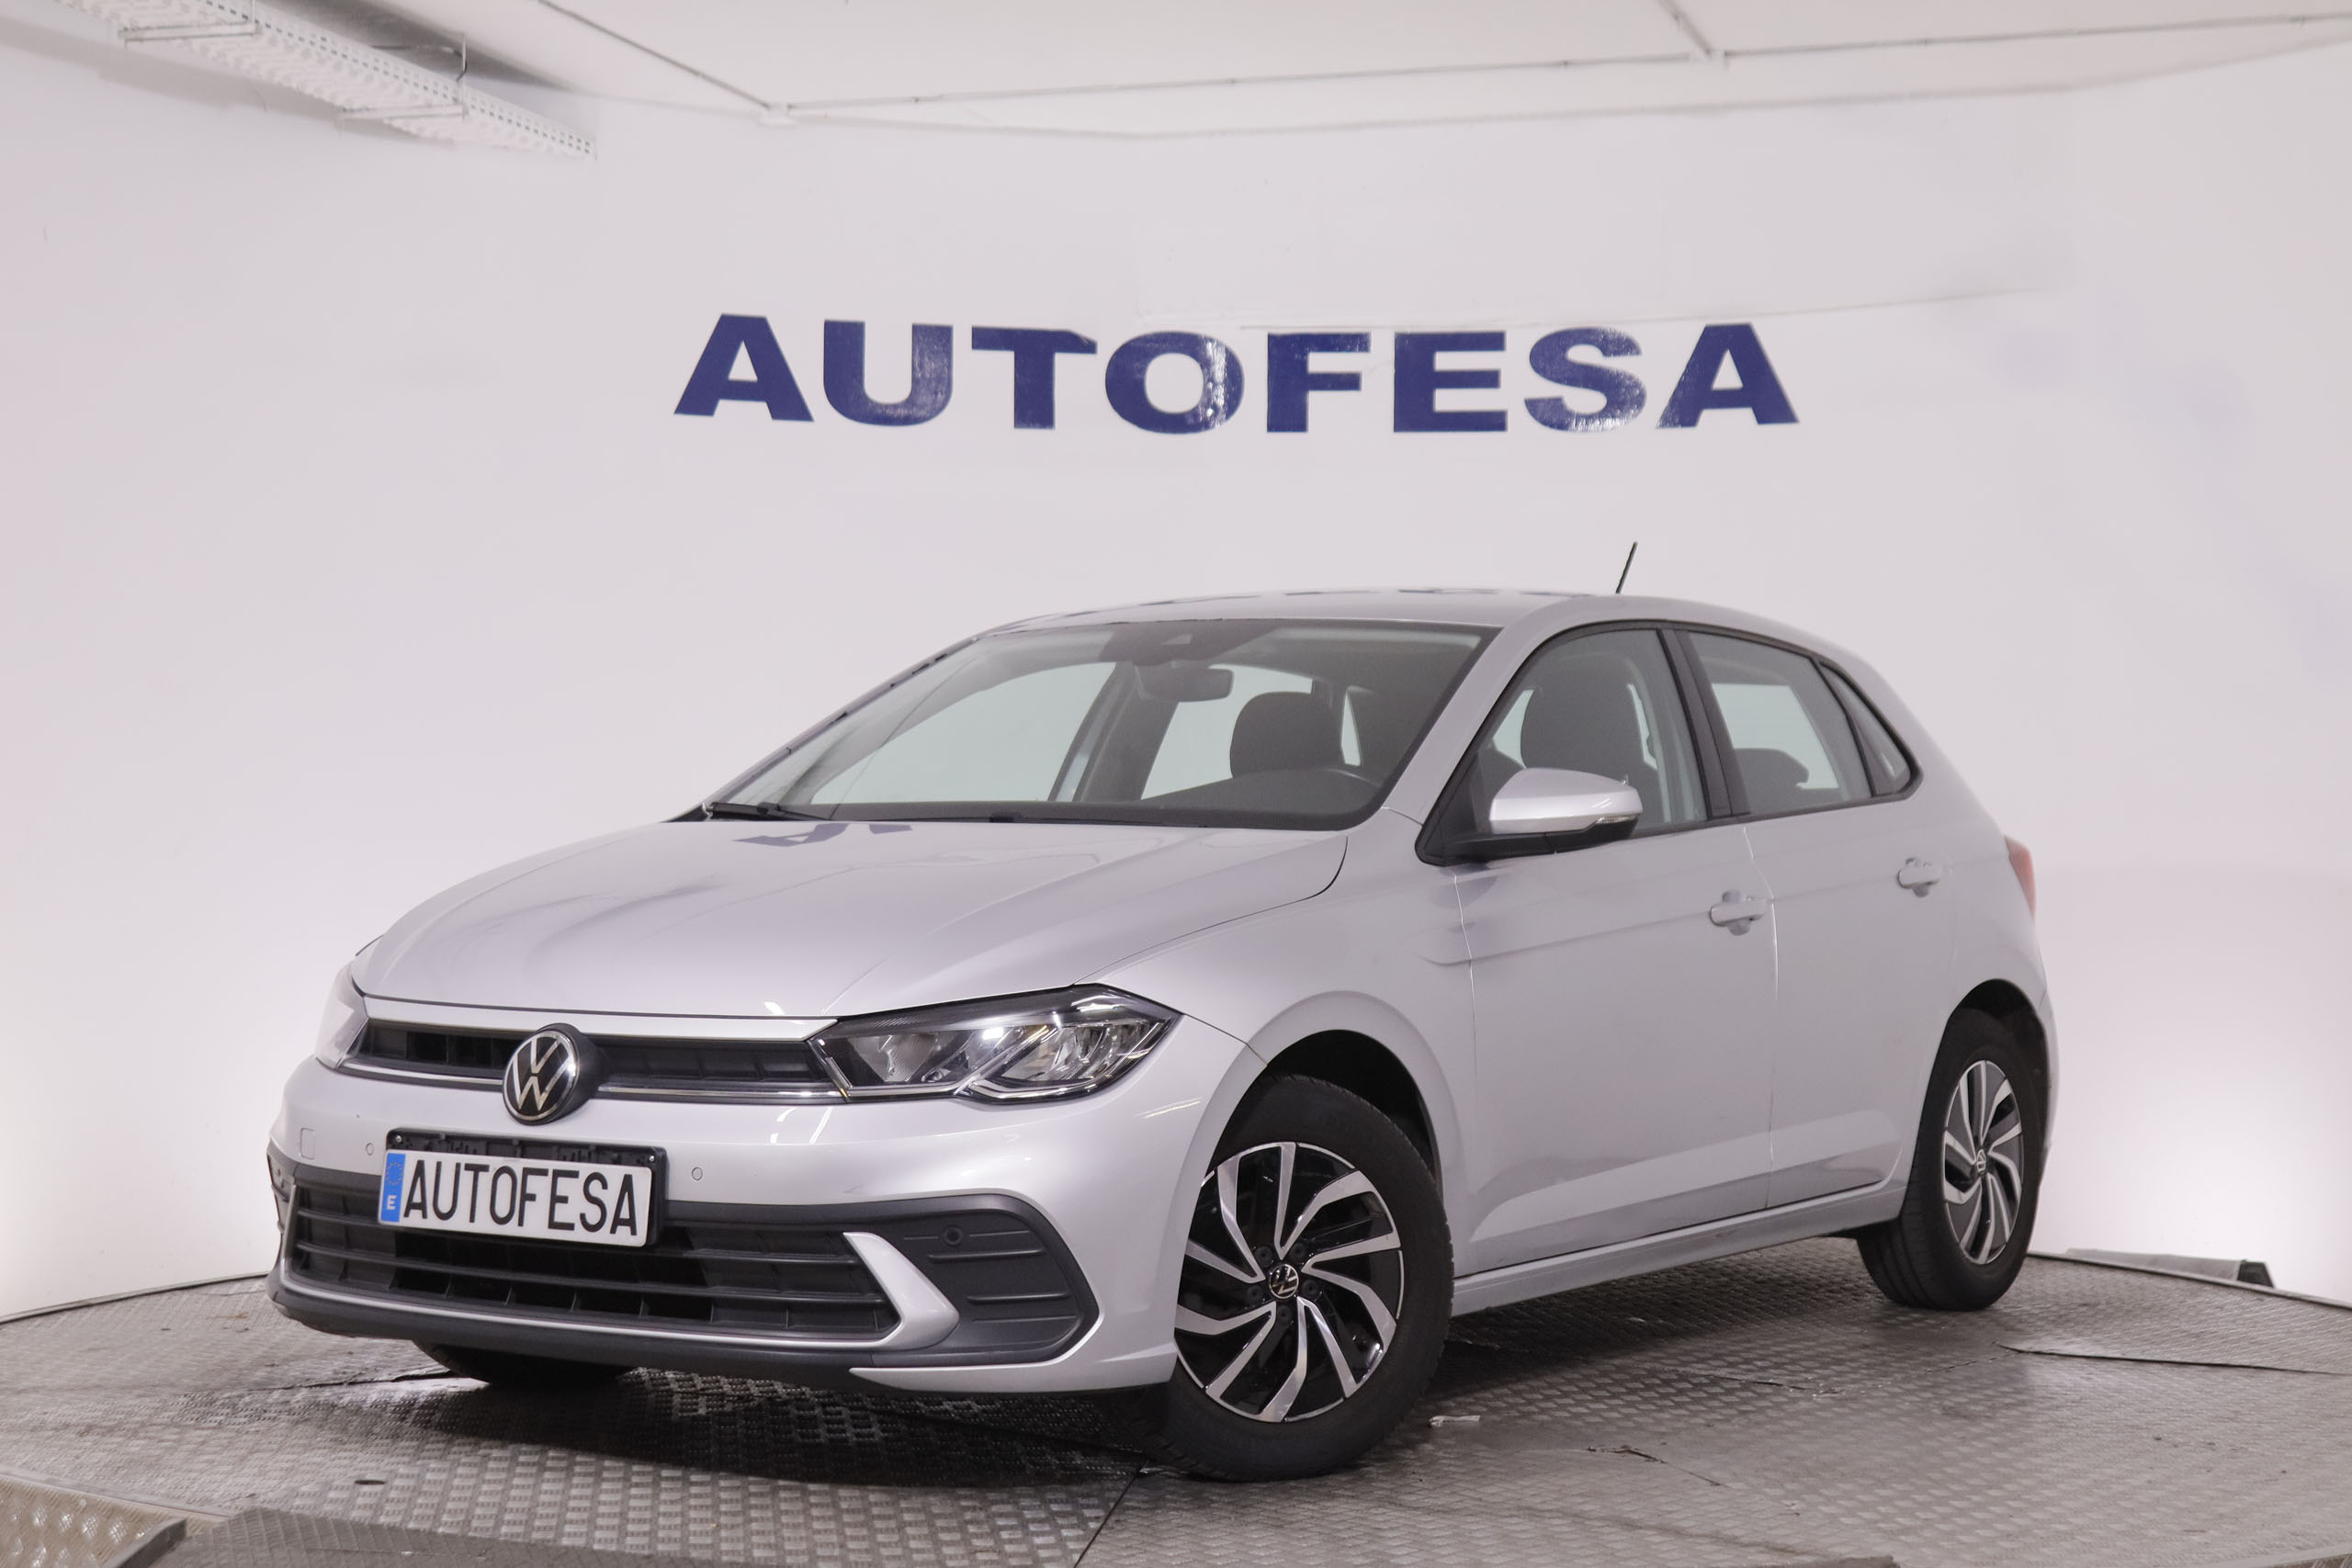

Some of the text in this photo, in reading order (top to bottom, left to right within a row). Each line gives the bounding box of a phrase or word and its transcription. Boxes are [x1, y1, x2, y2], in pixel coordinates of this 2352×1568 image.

[674, 314, 1798, 434] AUTOFESA
[505, 1031, 578, 1120] VW
[386, 1195, 397, 1210] E
[403, 1159, 638, 1235] AUTOFESA
